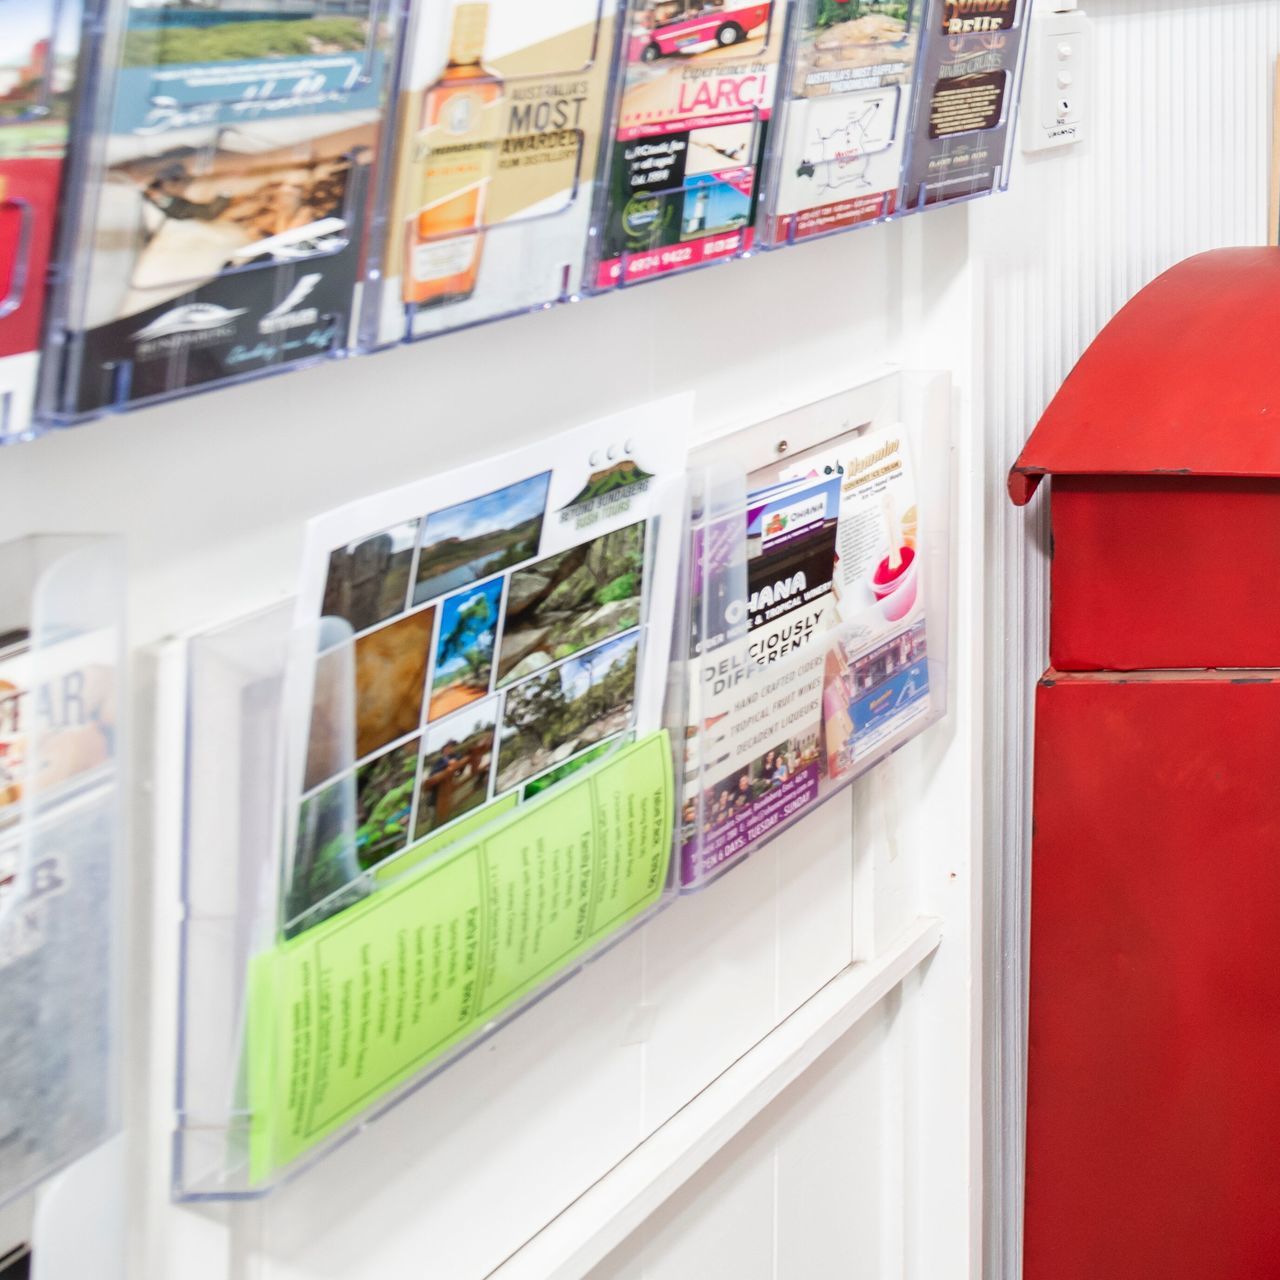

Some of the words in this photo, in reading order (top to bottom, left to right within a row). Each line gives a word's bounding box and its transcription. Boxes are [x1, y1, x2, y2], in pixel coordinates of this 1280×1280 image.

[677, 74, 766, 114] LARC!
[508, 96, 588, 134] MOST
[501, 128, 581, 154] AWARDED
[790, 501, 825, 523] OHANA
[724, 569, 808, 625] OHANA
[759, 672, 797, 703] CRAFTED
[729, 704, 771, 738] TROPICAL
[770, 691, 796, 718] FRUIT
